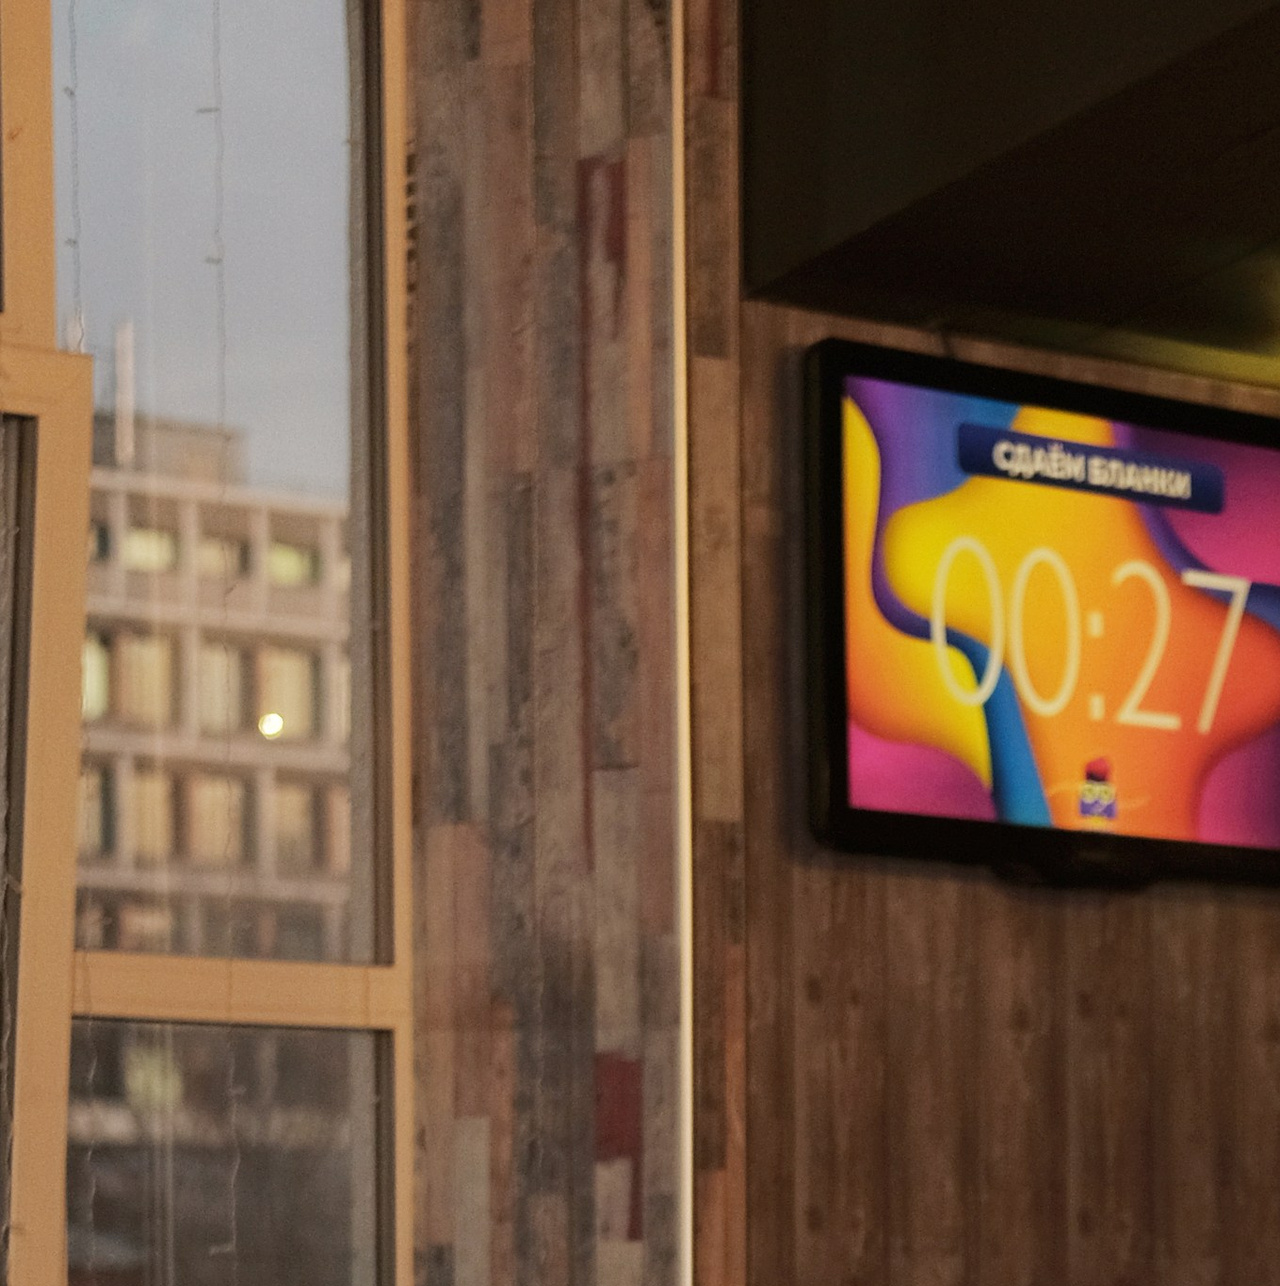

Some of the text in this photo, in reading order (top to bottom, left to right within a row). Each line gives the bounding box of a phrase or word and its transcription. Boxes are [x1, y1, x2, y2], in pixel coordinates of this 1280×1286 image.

[991, 439, 1192, 500] СДАЁМ БЛАНКИ
[931, 536, 1252, 734] 00:27
